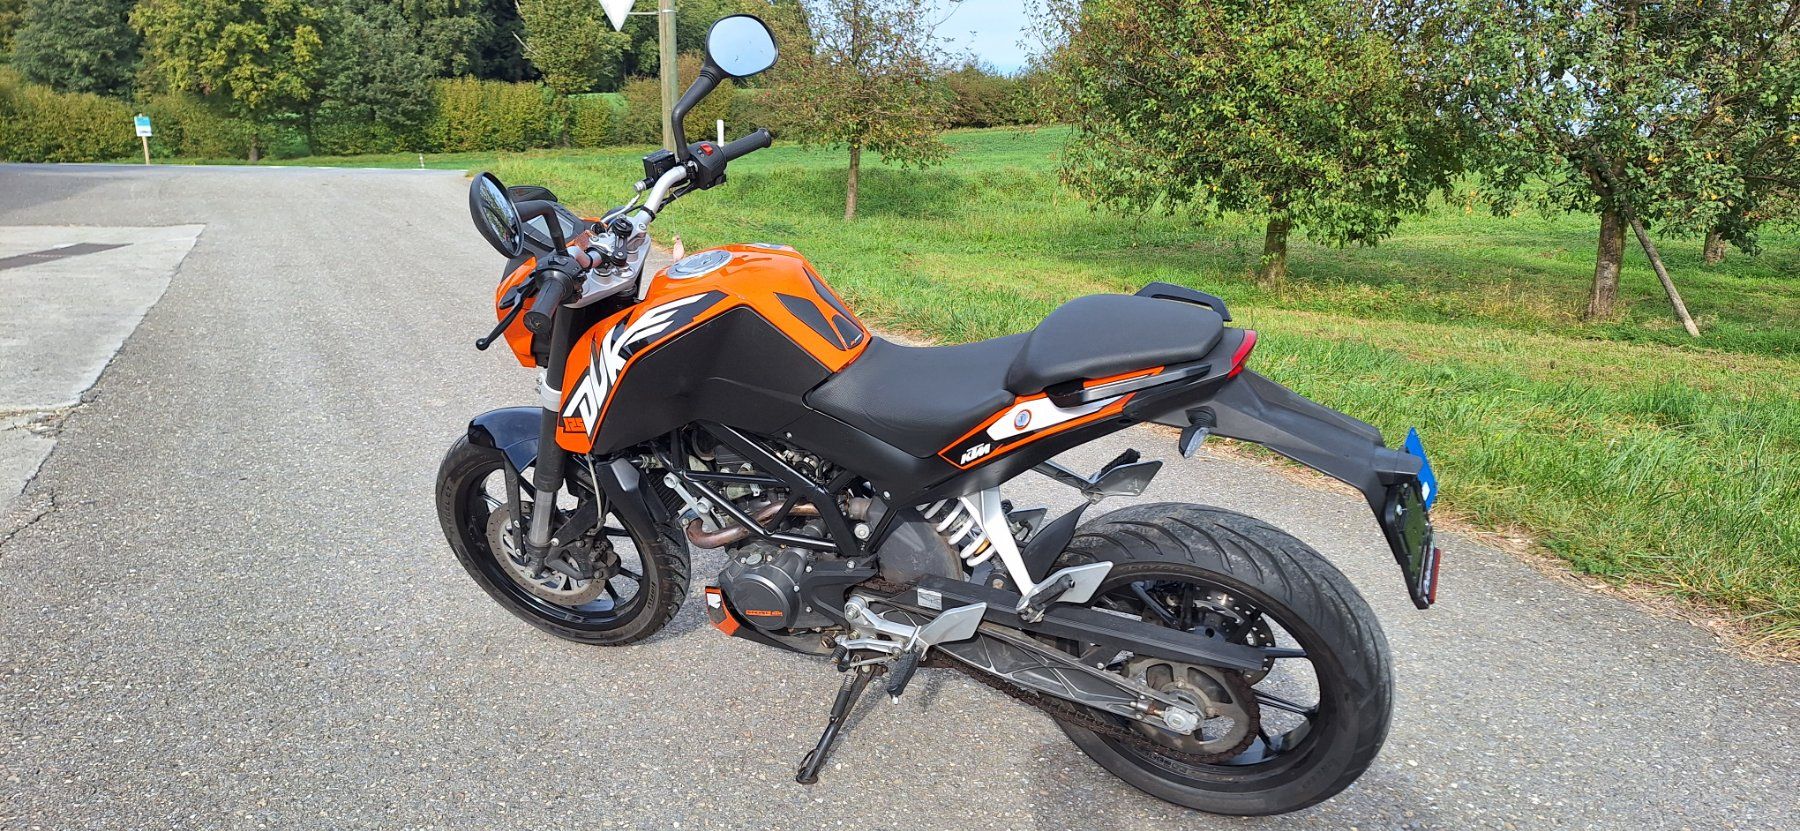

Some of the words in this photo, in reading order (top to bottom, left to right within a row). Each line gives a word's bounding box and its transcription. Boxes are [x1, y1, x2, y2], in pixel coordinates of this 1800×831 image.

[562, 292, 709, 437] DUKE
[564, 418, 586, 432] 125
[960, 443, 991, 465] KTM
